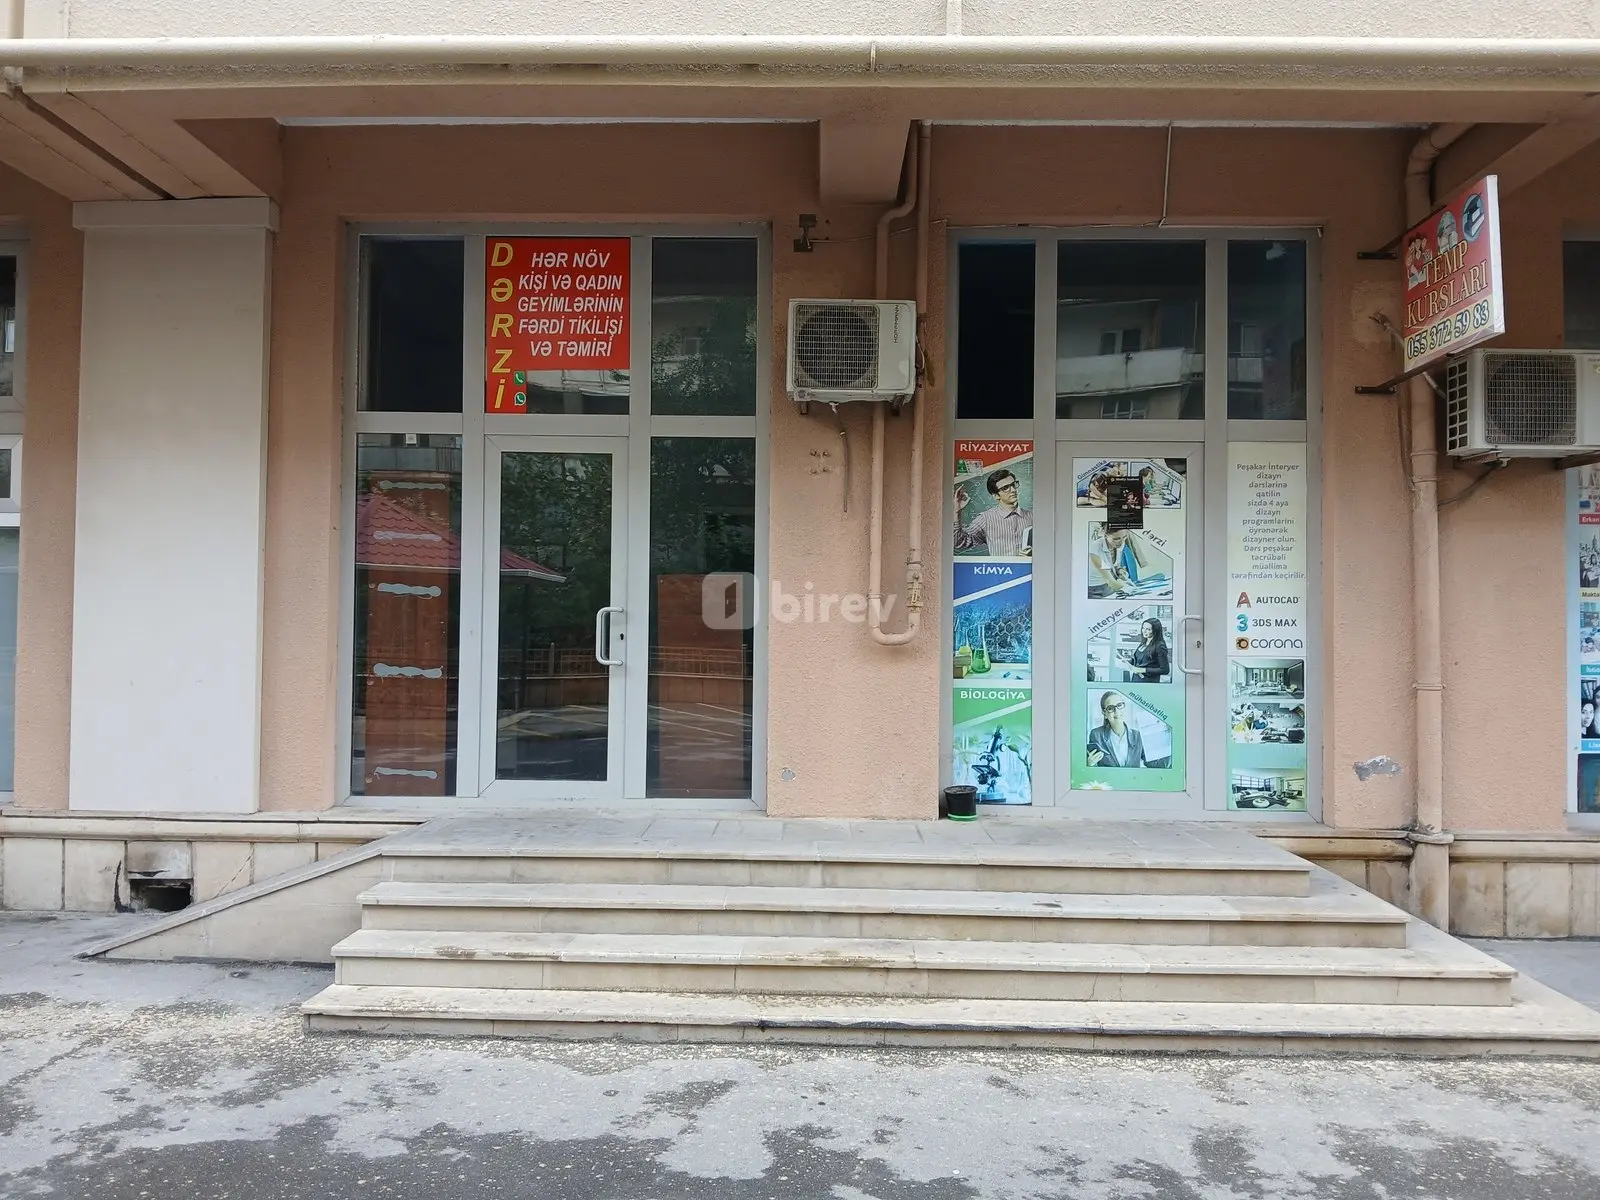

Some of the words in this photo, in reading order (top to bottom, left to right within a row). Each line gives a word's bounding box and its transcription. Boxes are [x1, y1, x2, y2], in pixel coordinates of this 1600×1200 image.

[531, 252, 569, 268] HƏR
[572, 249, 611, 268] NÖV
[1423, 239, 1468, 289] TEMP
[518, 271, 549, 293] KİŞİ
[551, 274, 572, 290] VƏ
[575, 274, 623, 291] QADIN
[518, 293, 623, 312] GEYİMLƏRİNİN
[1406, 259, 1489, 329] KURSLARI
[491, 242, 514, 409] DƏRZİ
[518, 315, 566, 335] FƏRDİ
[568, 315, 624, 338] TİKİLİŞİ
[1406, 329, 1429, 360] 055
[1428, 318, 1452, 351] 372
[1453, 308, 1471, 339] 59
[1472, 299, 1490, 328] 83
[530, 341, 552, 357] VƏ
[557, 337, 613, 357] TƏMİRİ
[960, 442, 1030, 452] RİYAZİYYAT
[1256, 472, 1282, 481] dizayn
[1255, 508, 1281, 517] dizayn
[1275, 500, 1289, 508] aya
[1142, 529, 1168, 548] dərzi
[1242, 535, 1276, 544] dizayner
[973, 564, 1013, 575] KİMYA
[1256, 596, 1299, 604] AUTOCAD
[1088, 607, 1125, 635] interyer
[1252, 618, 1272, 627] 3DS
[1274, 618, 1298, 627] MAX
[1250, 638, 1303, 649] corona
[960, 688, 1026, 700] BİOLOGİYA
